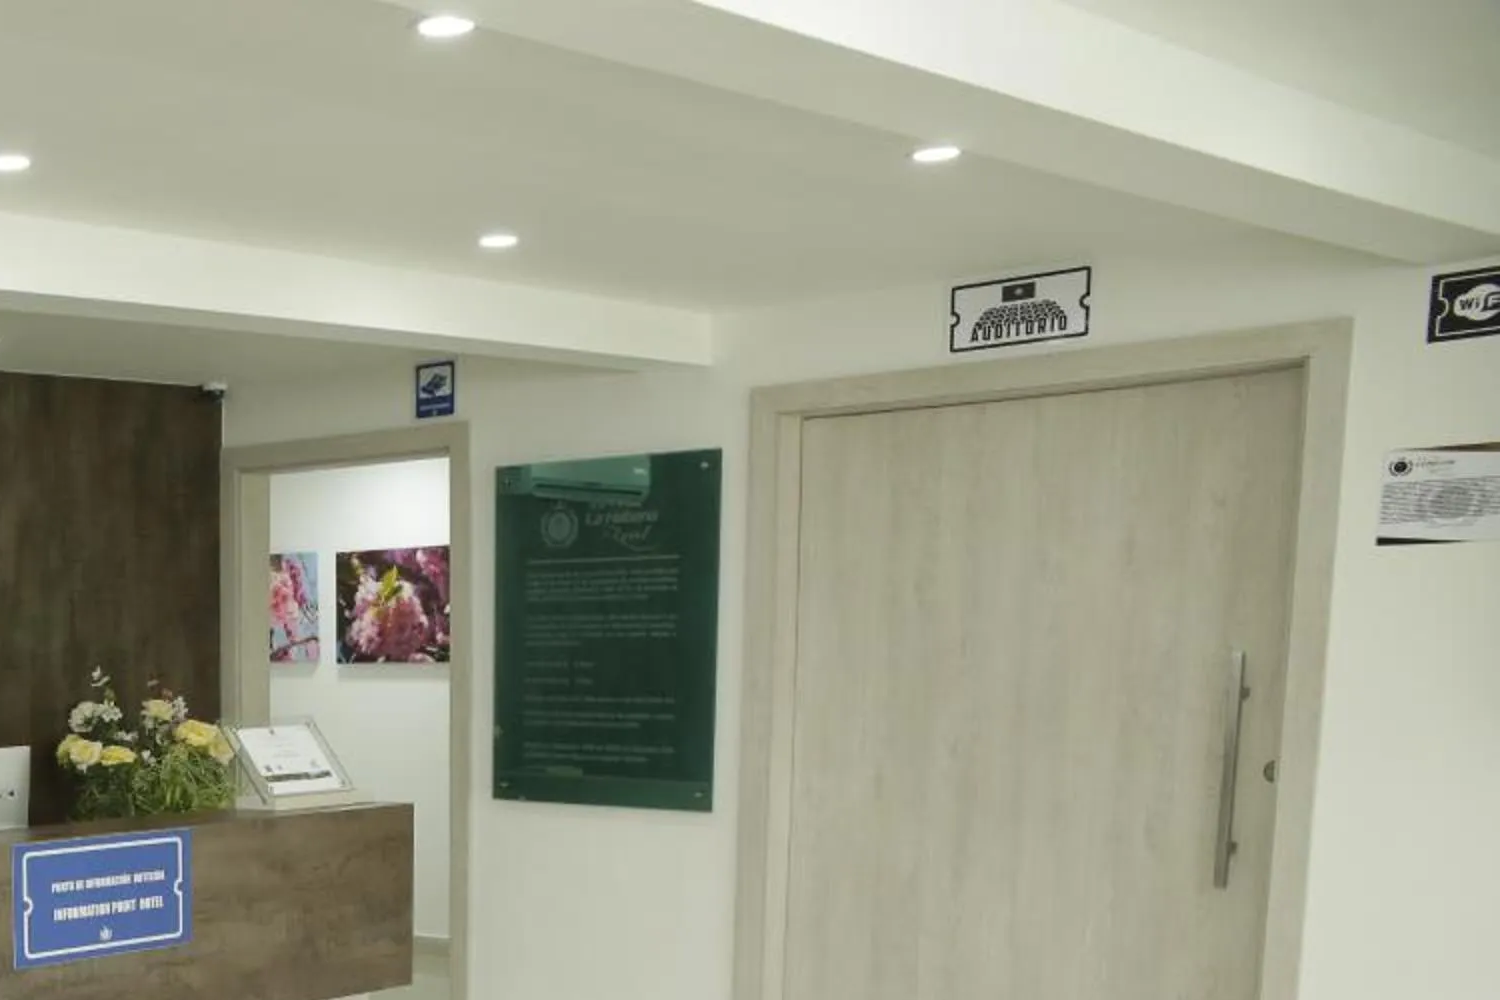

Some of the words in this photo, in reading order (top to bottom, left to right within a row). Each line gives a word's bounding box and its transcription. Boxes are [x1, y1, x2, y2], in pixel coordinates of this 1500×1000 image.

[970, 315, 1067, 343] AUDITORIO
[53, 902, 111, 921] INFORMATION
[111, 898, 137, 914] POINT
[139, 895, 164, 910] HOTEL
